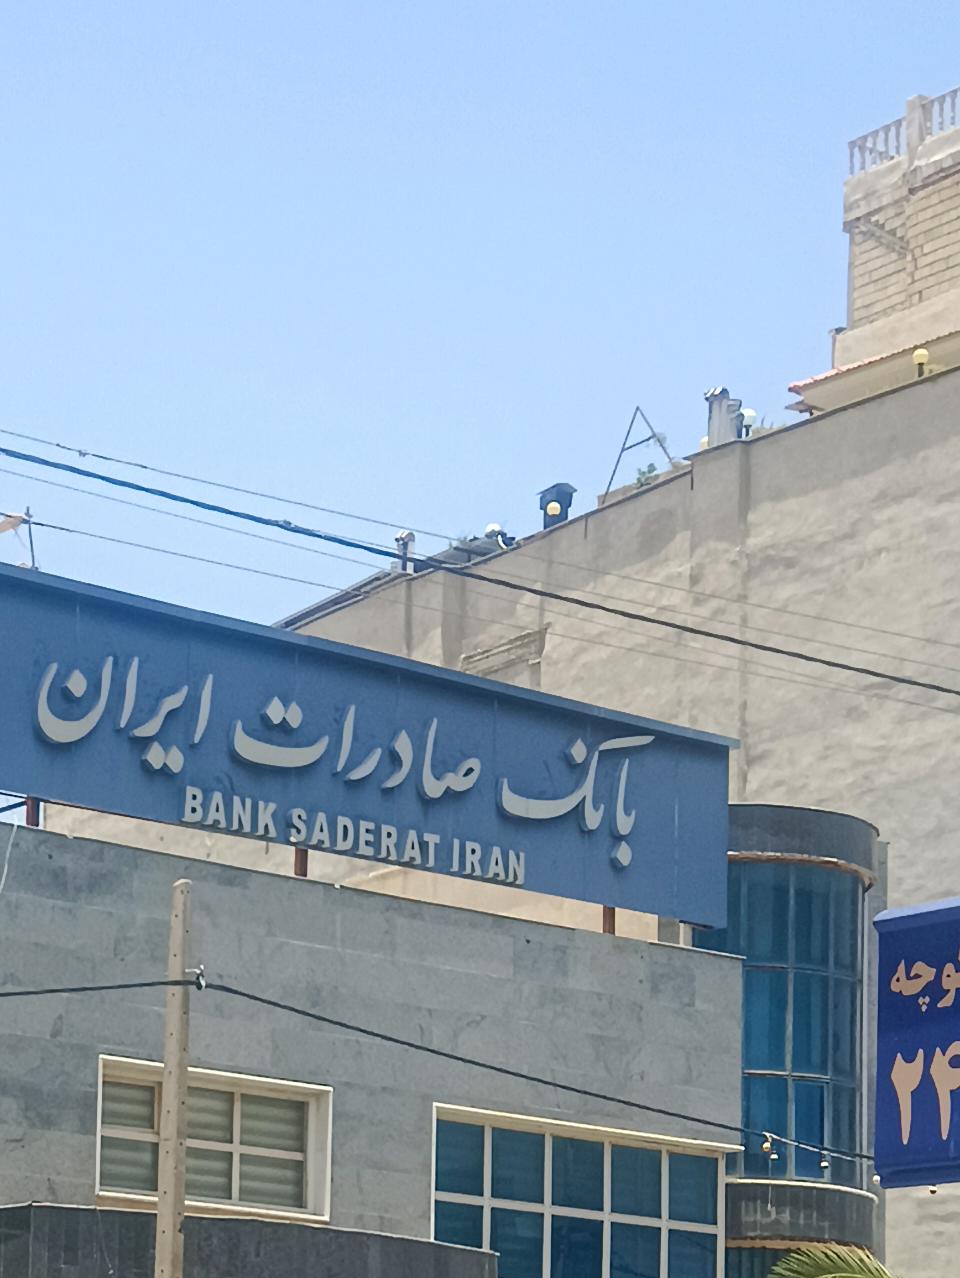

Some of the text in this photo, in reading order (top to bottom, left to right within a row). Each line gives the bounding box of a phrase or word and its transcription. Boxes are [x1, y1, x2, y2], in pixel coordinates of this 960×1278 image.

[36, 654, 655, 869] بانک صادرات ایران
[182, 785, 526, 885] BANK SADERAT IRAN
[890, 946, 960, 1015] وچه
